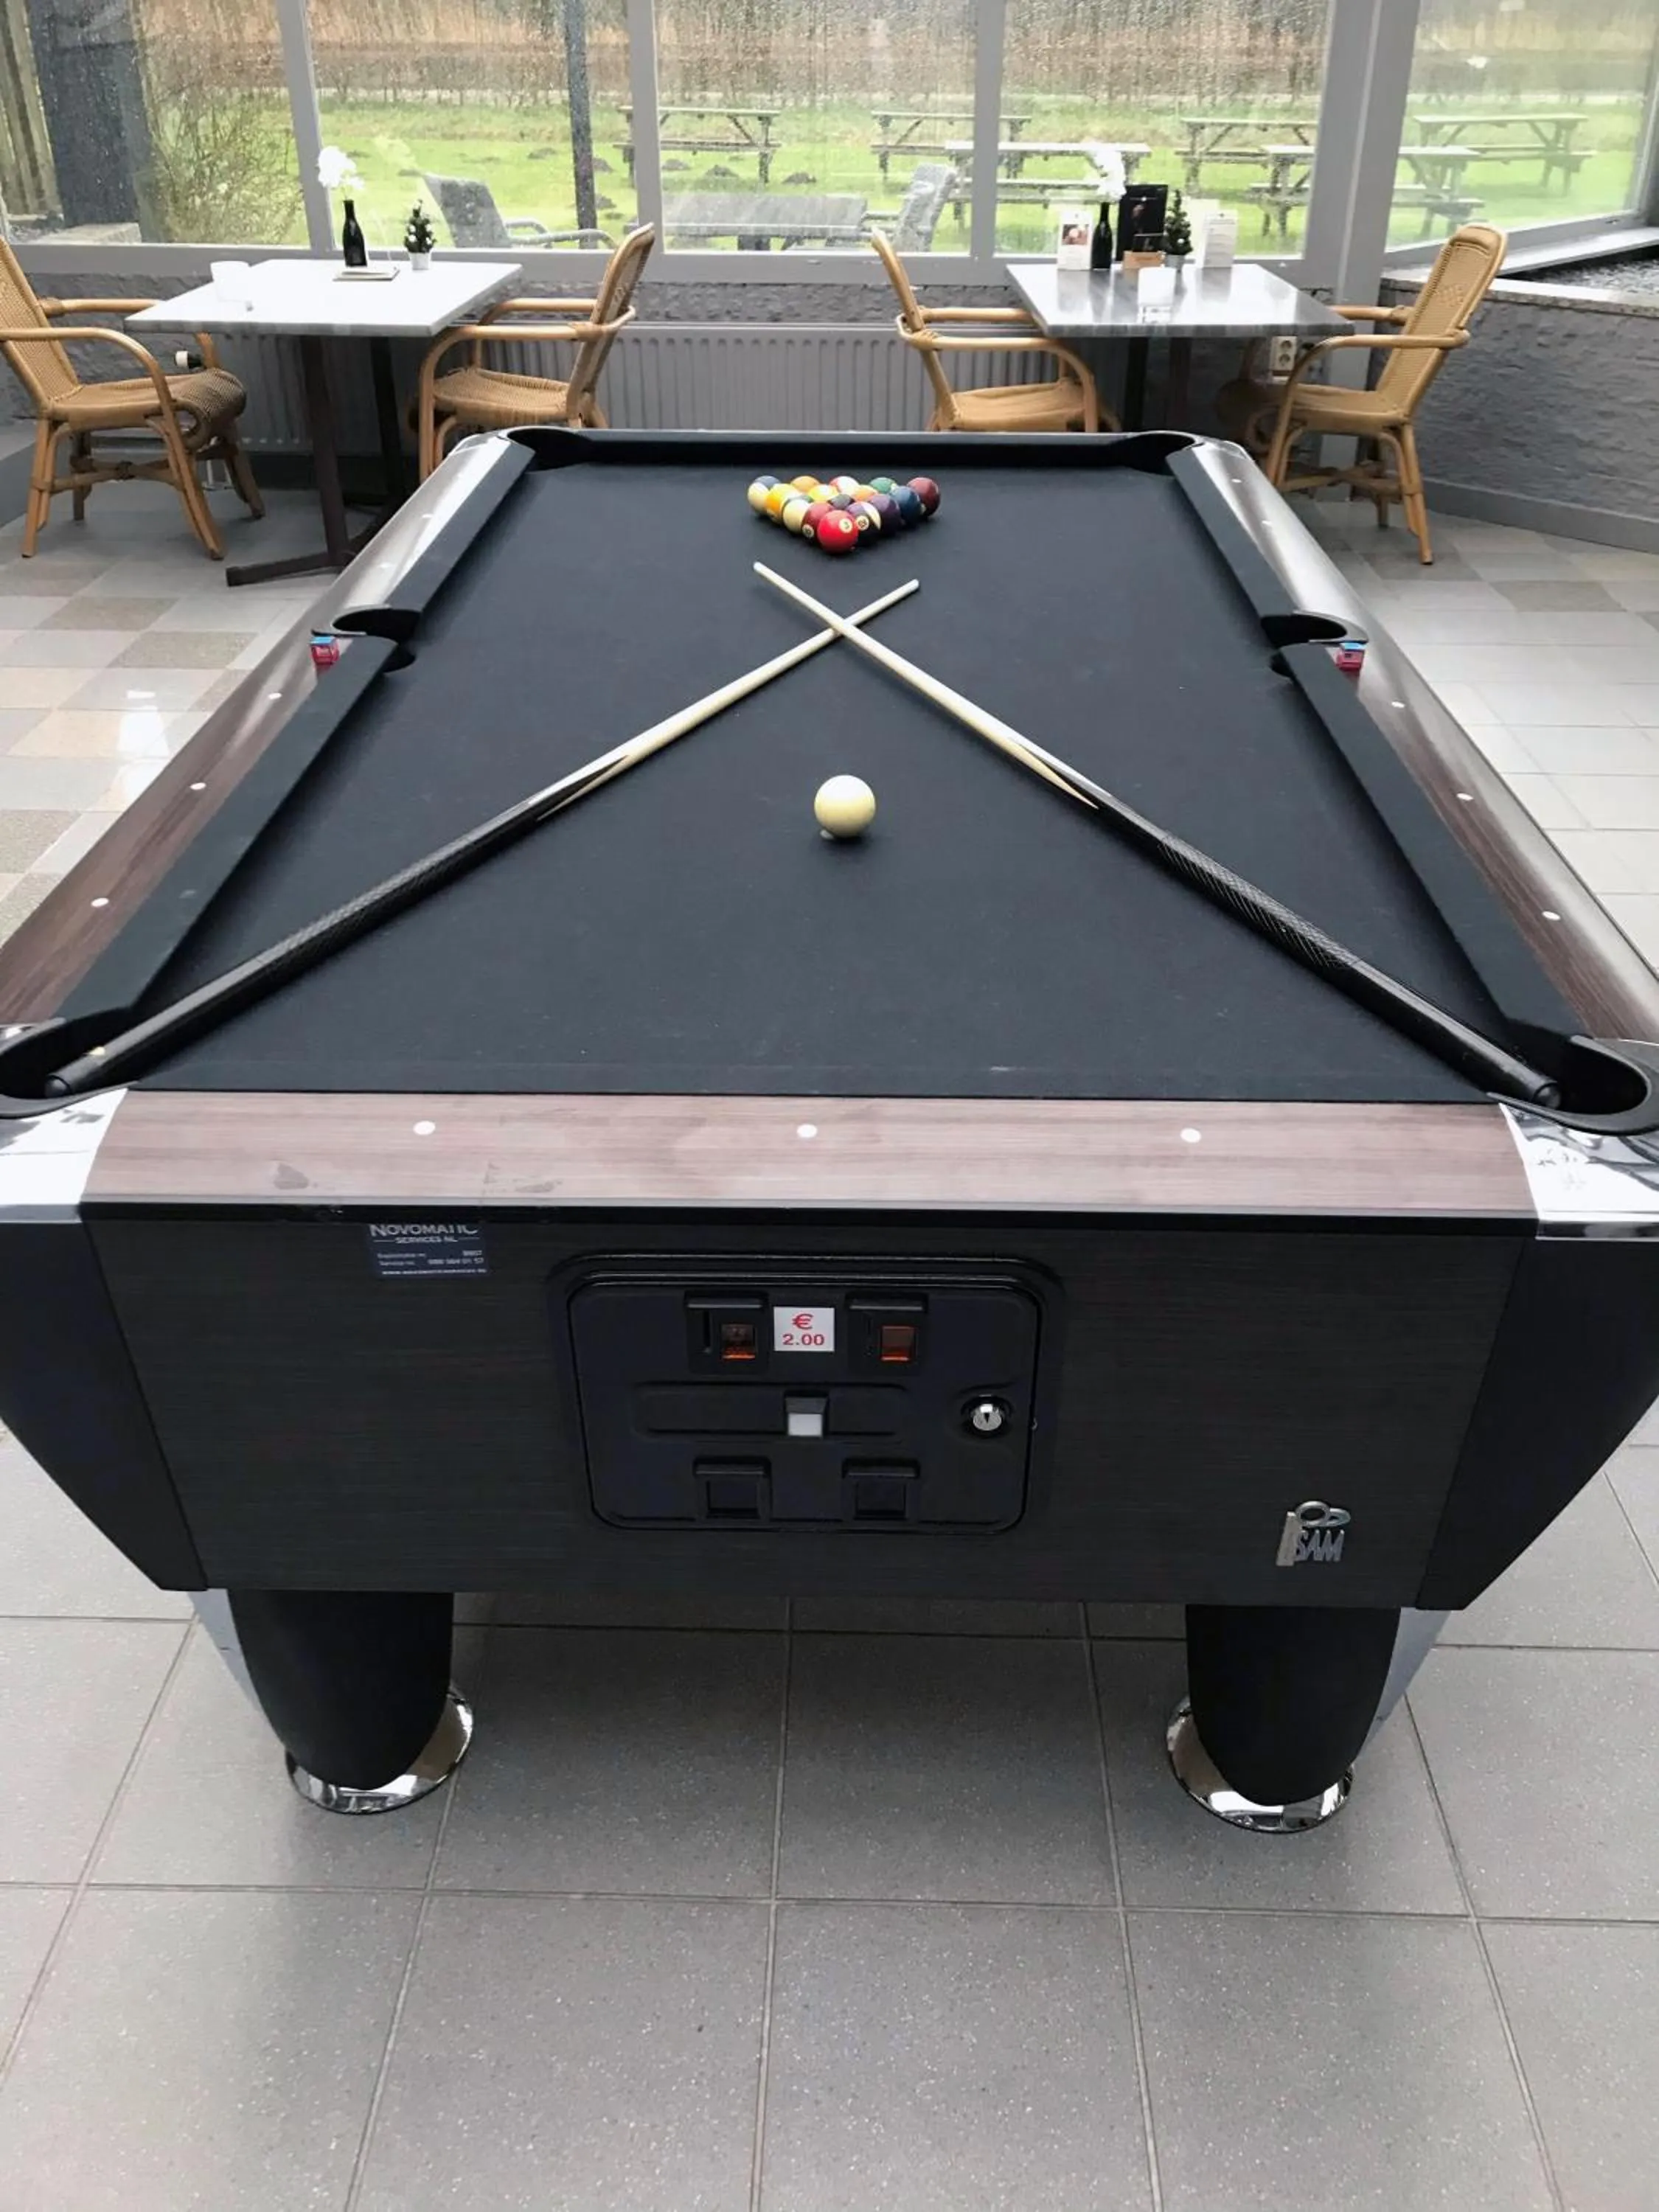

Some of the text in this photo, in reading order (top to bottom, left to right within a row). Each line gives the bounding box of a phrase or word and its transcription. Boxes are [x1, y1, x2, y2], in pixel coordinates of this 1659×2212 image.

[792, 1313, 813, 1330] €
[782, 1333, 825, 1346] 2.00
[1295, 1529, 1345, 1562] SAM
